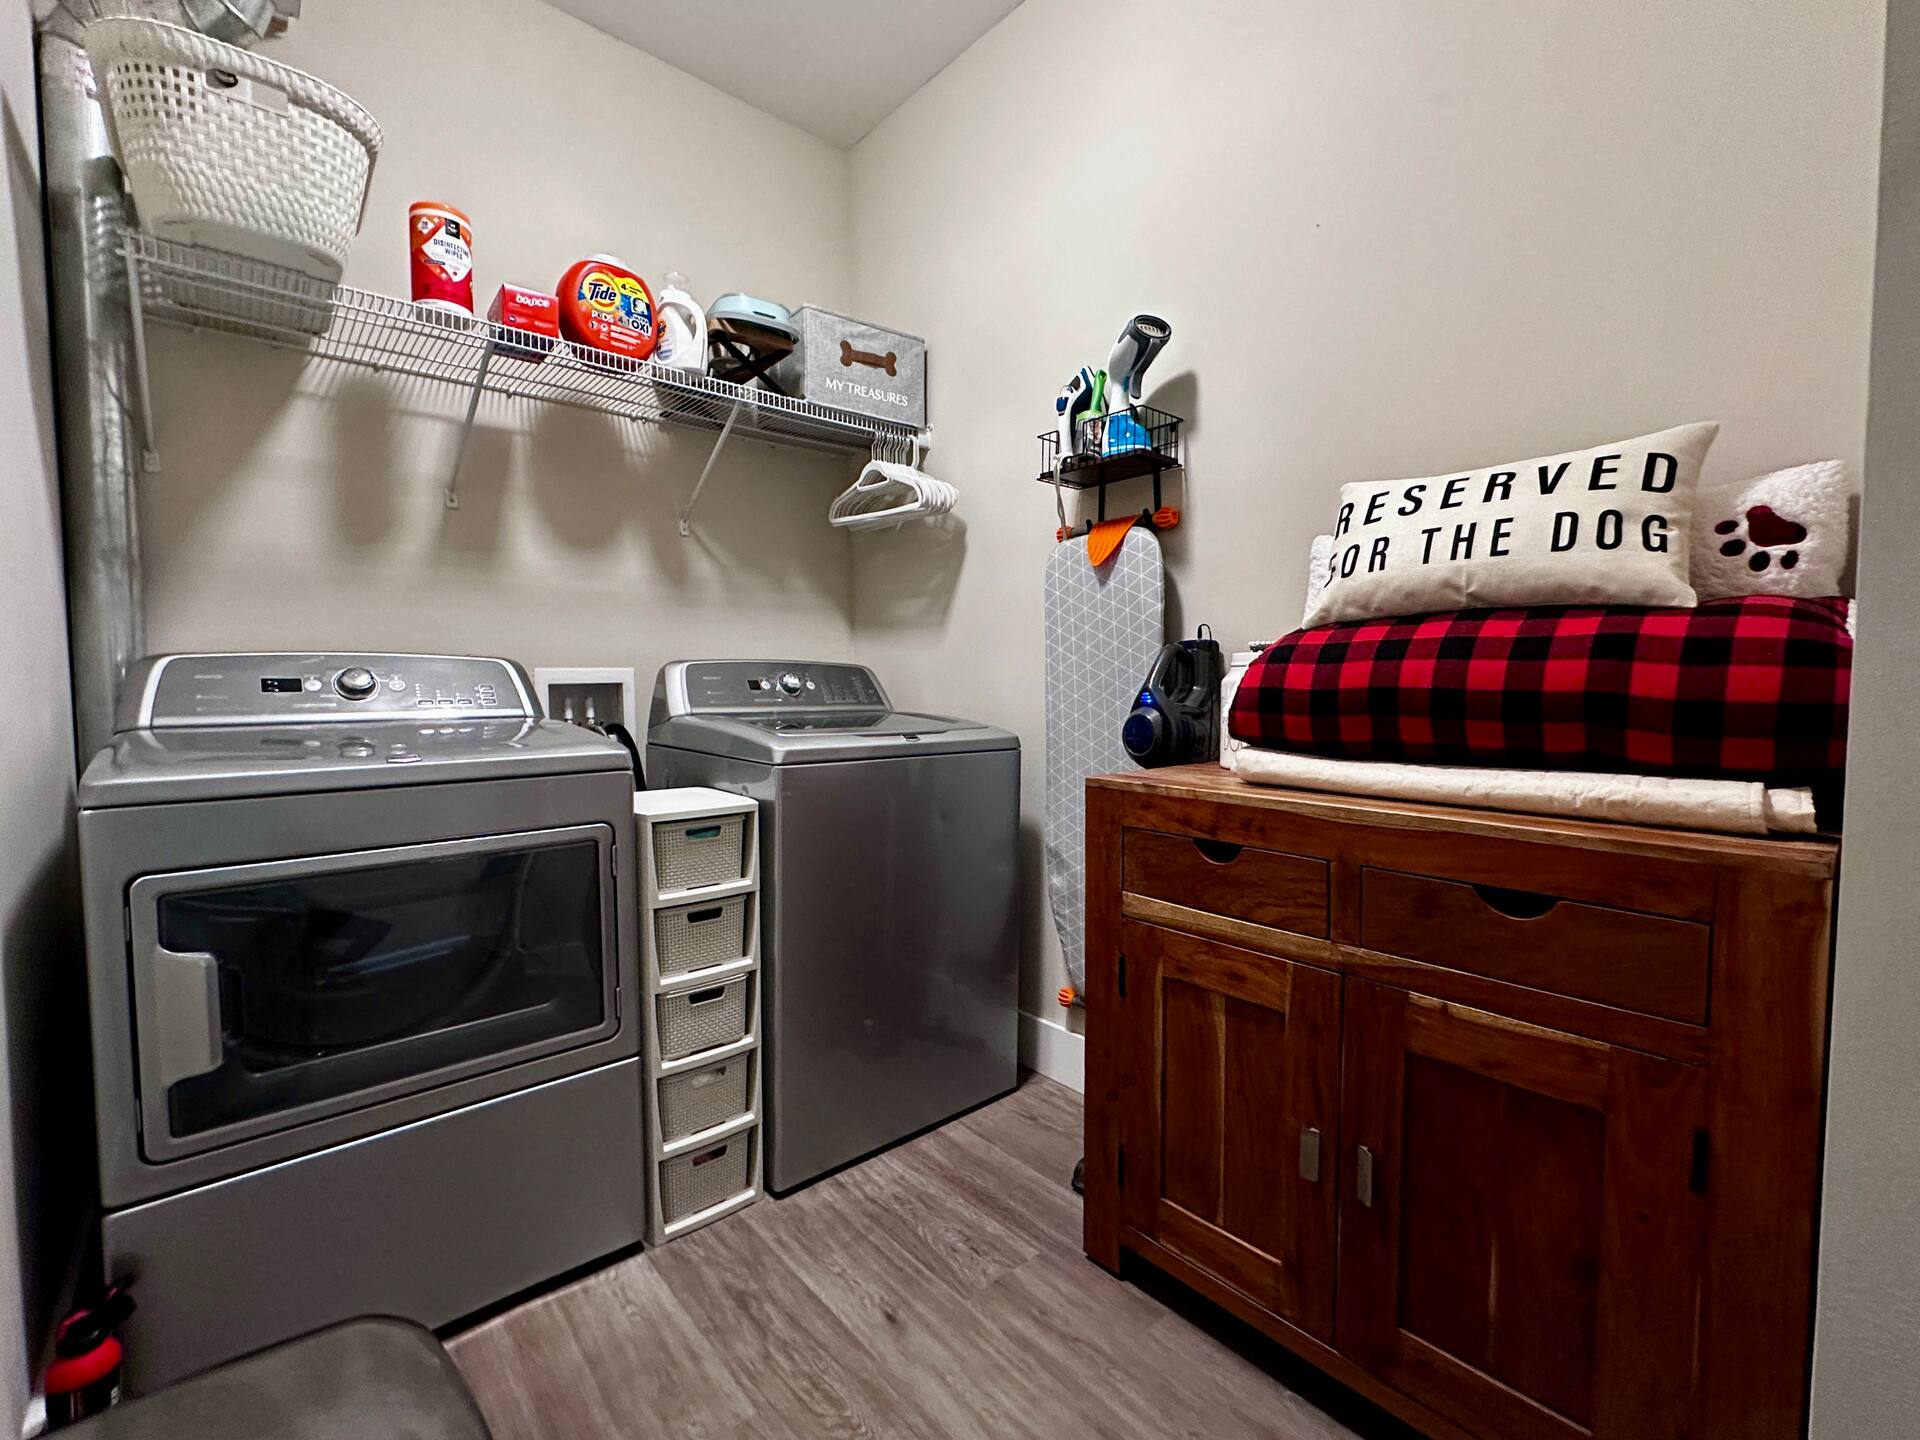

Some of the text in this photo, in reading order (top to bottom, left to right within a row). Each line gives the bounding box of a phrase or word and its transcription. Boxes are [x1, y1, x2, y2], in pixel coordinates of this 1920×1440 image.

[516, 293, 550, 308] bounce
[589, 282, 617, 301] Tide
[631, 320, 649, 334] OXI
[825, 376, 909, 407] MY TREASURES
[1335, 452, 1678, 541] RESERVED
[1421, 517, 1514, 565] THE
[1550, 509, 1668, 553] DOG
